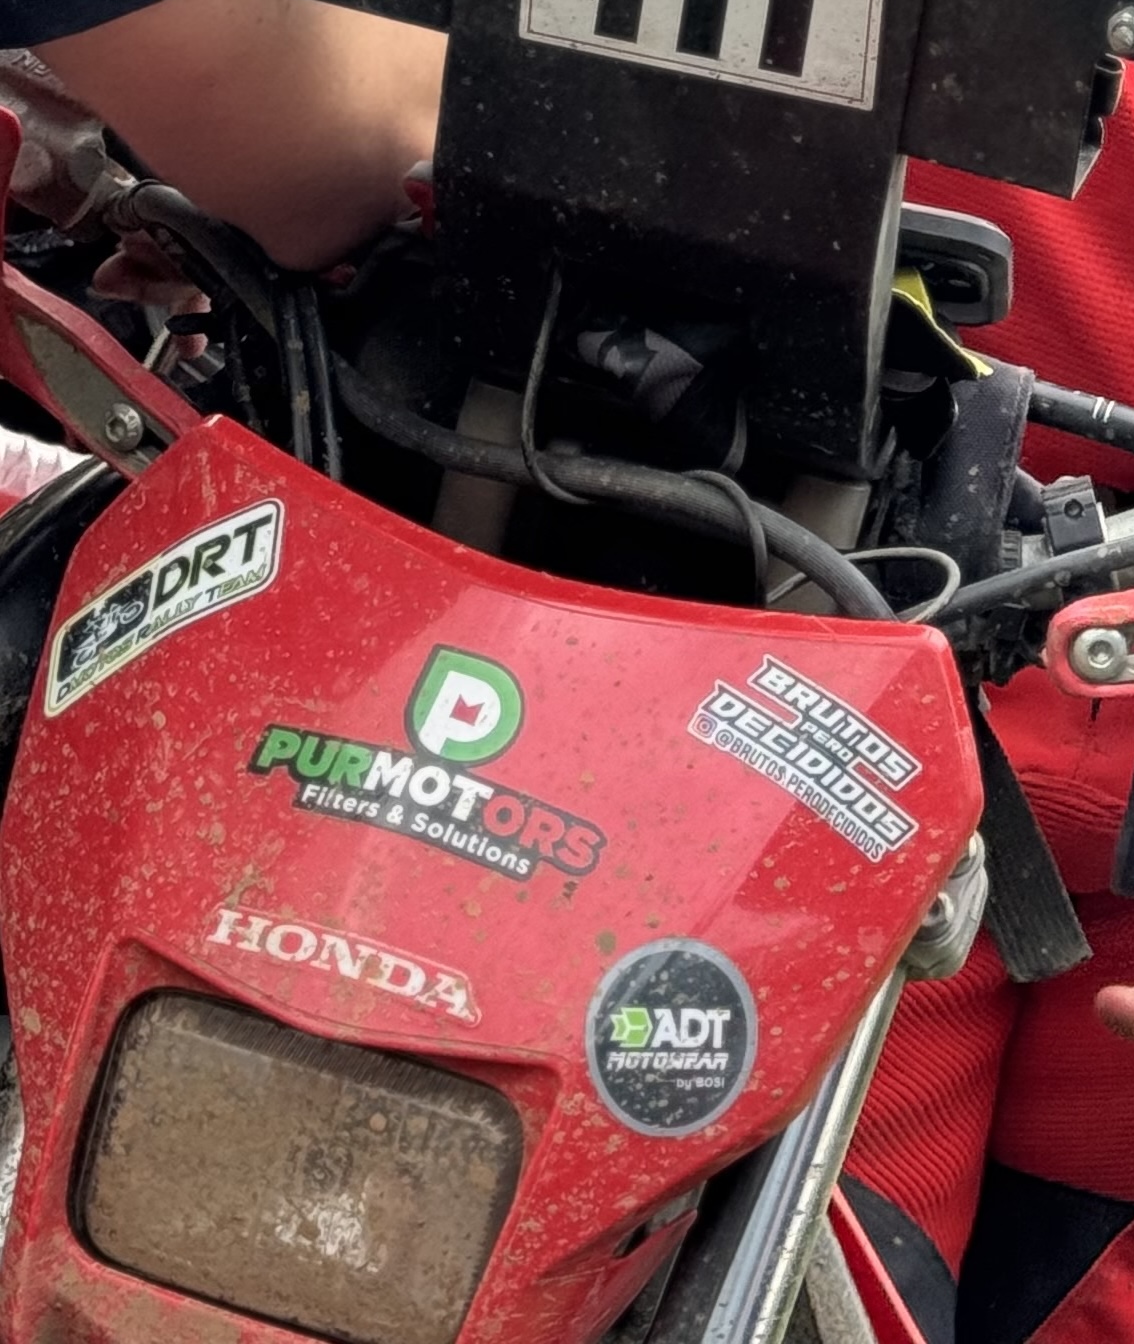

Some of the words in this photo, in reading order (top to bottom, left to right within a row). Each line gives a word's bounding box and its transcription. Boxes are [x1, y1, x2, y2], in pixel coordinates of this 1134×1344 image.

[152, 512, 273, 611] DRT
[709, 692, 910, 843] DECIDIDOS
[756, 665, 914, 783] BRUTOS
[800, 721, 855, 762] PERO
[256, 727, 599, 869] PURMOTORS
[301, 783, 381, 819] Filters
[386, 804, 405, 826] &
[411, 811, 531, 876] Solutions
[206, 908, 478, 1023] HONDA
[606, 1051, 729, 1072] MOTOWEAR
[651, 1007, 731, 1049] ADT
[676, 1077, 692, 1091] by
[696, 1076, 726, 1089] BOSI
